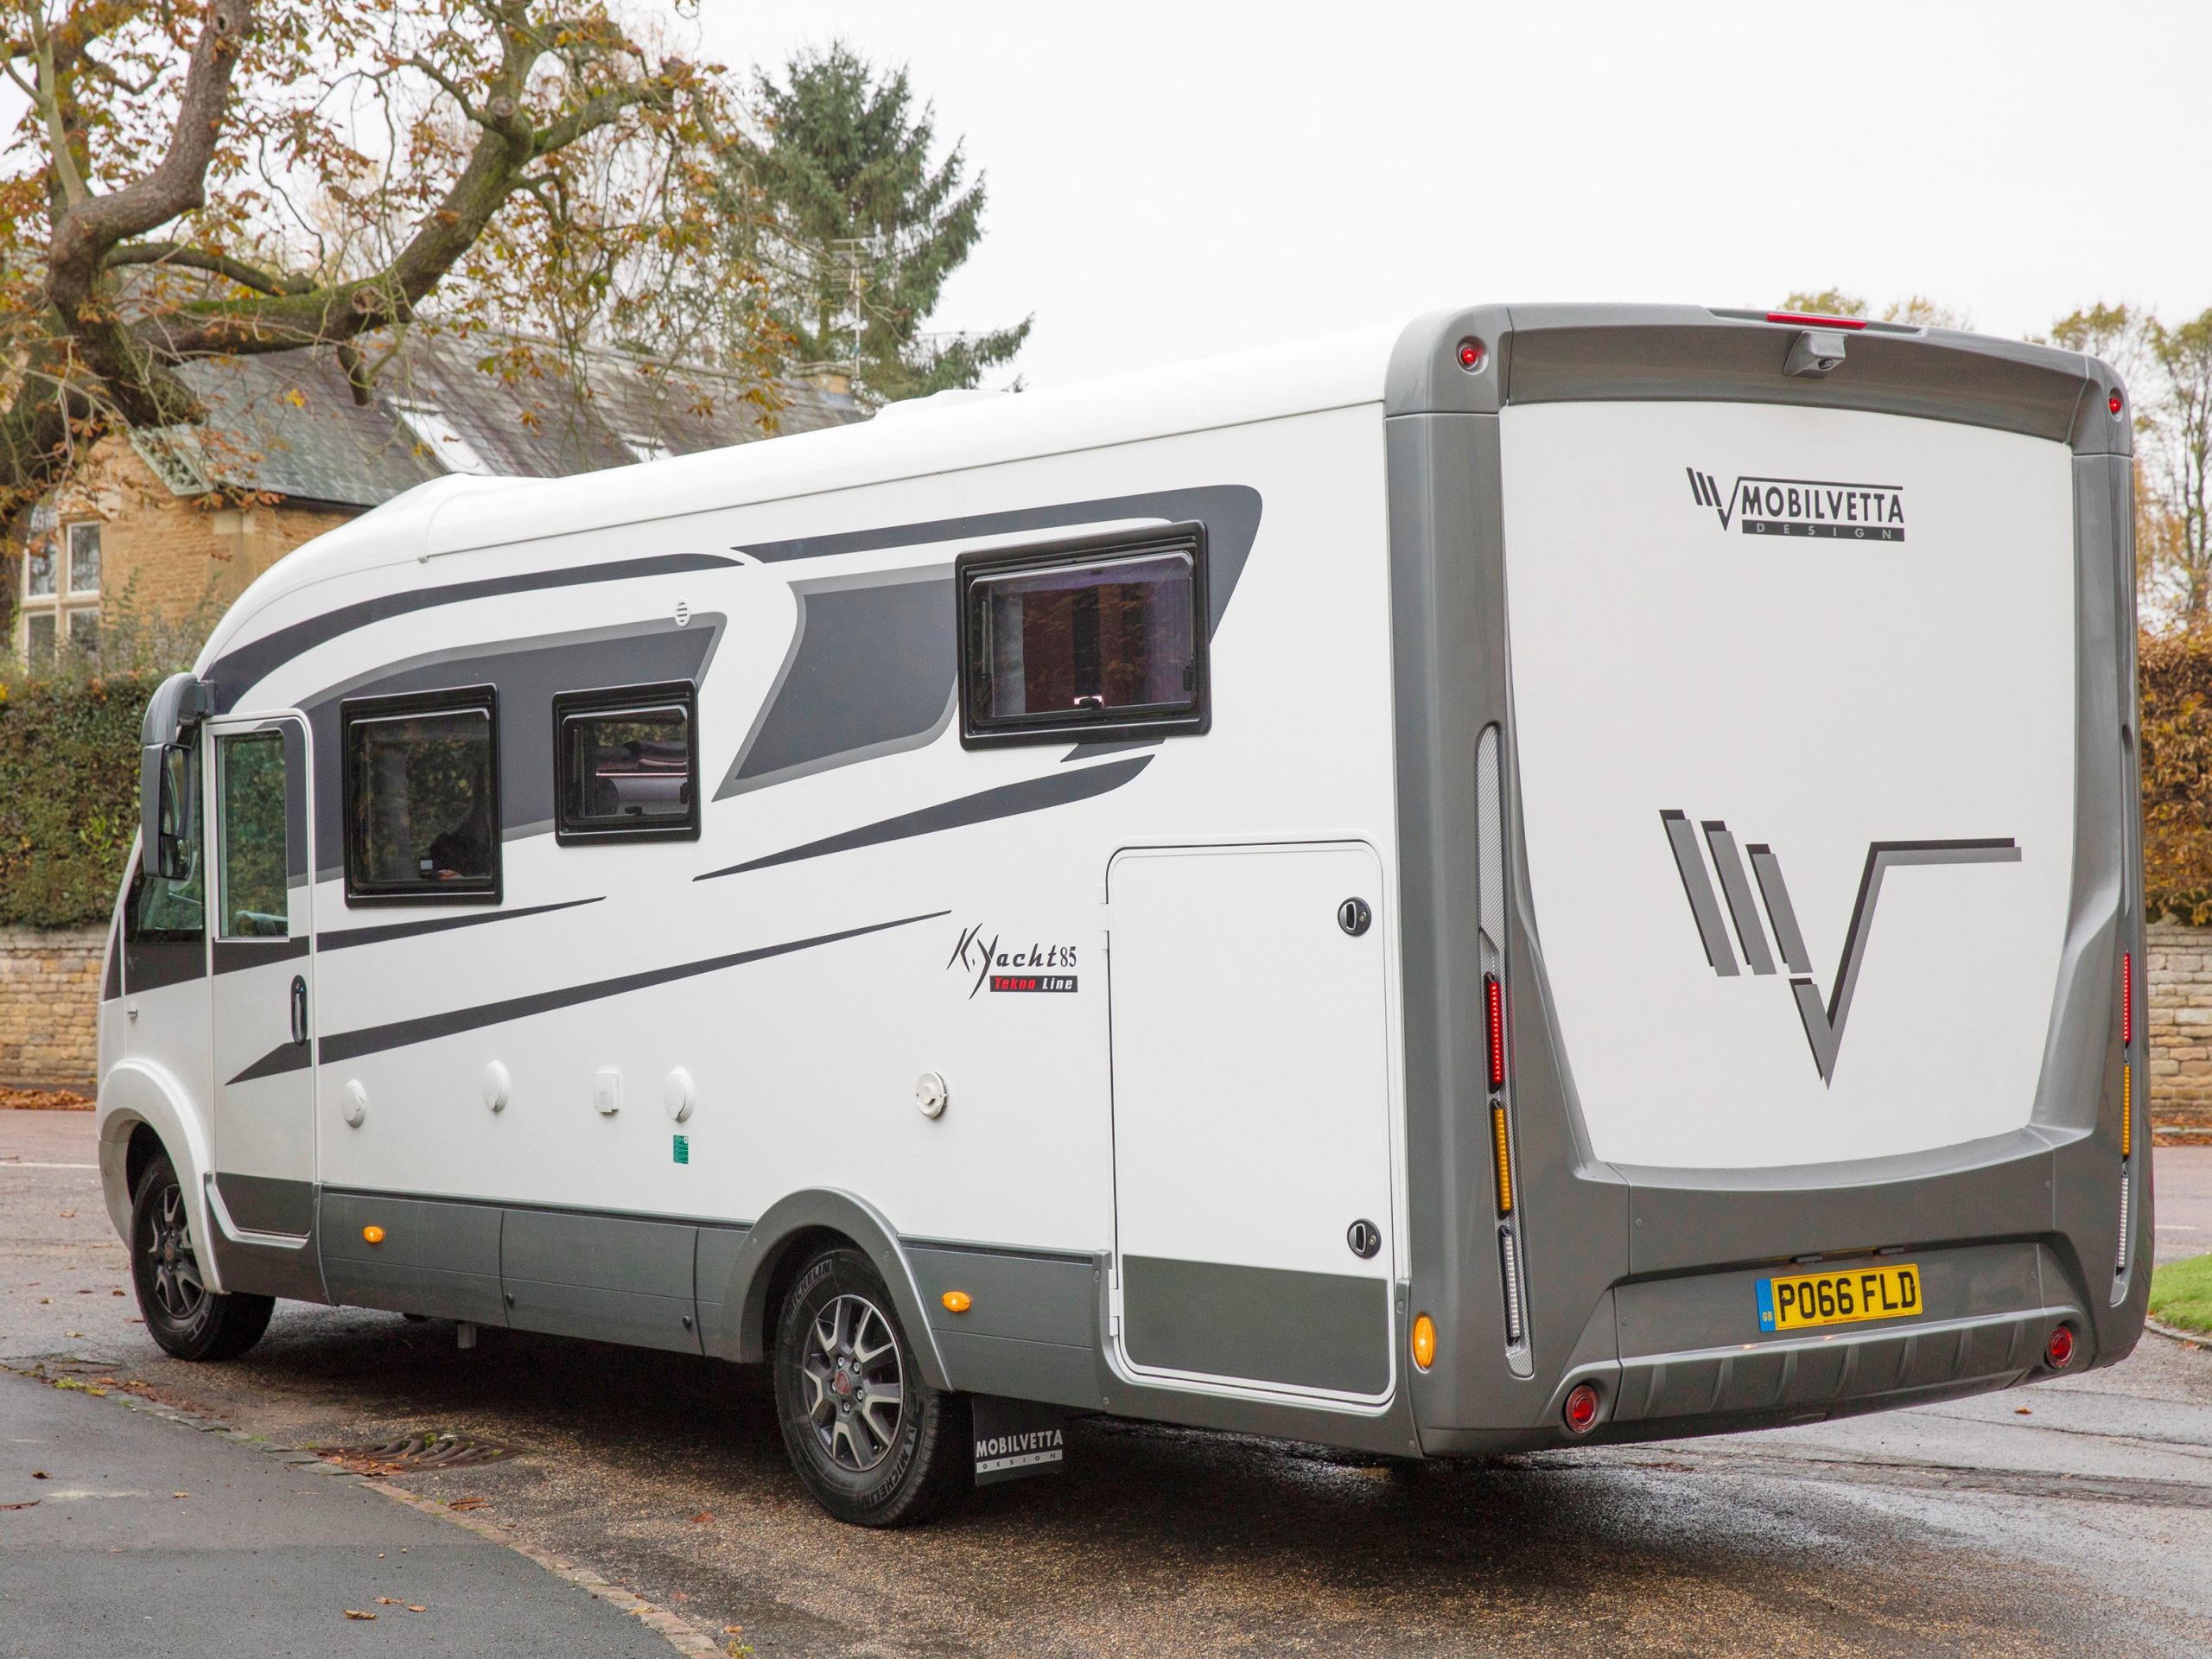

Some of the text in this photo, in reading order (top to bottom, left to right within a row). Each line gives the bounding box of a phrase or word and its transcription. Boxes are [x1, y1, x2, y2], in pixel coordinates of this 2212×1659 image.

[1741, 486, 1904, 523] MOBILVETTA
[1756, 522, 1892, 540] DESIGN
[995, 977, 1073, 990] Tekno Line
[1777, 1270, 1916, 1322] PO66 FLD
[976, 1429, 1064, 1459] MOBILVETTA
[982, 1452, 1056, 1470] DESIGN
